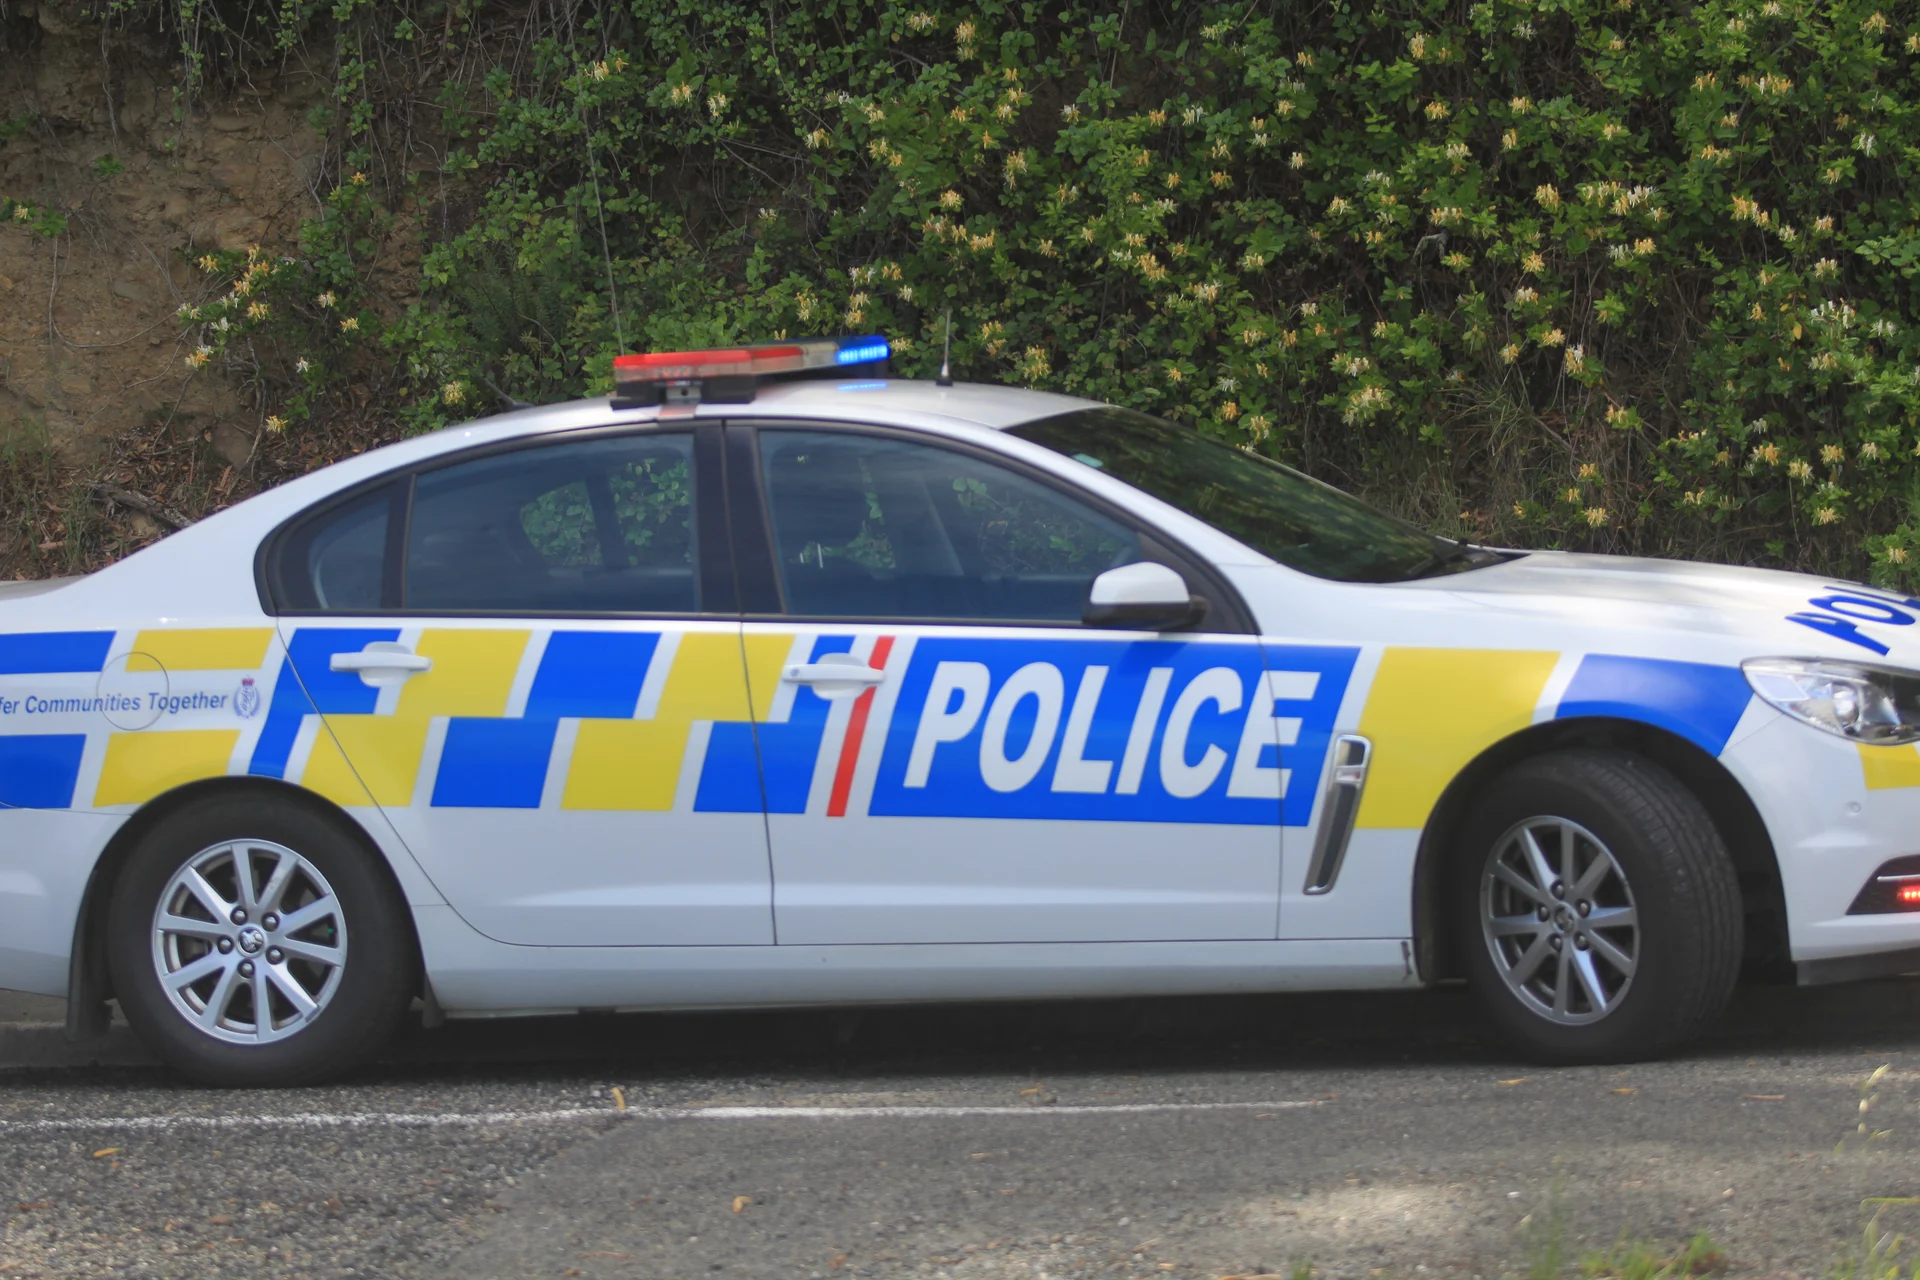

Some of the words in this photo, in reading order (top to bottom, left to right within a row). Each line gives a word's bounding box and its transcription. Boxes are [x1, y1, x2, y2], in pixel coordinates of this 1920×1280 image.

[25, 695, 141, 714] Communities
[148, 691, 228, 713] Together
[903, 660, 1321, 799] POLICE
